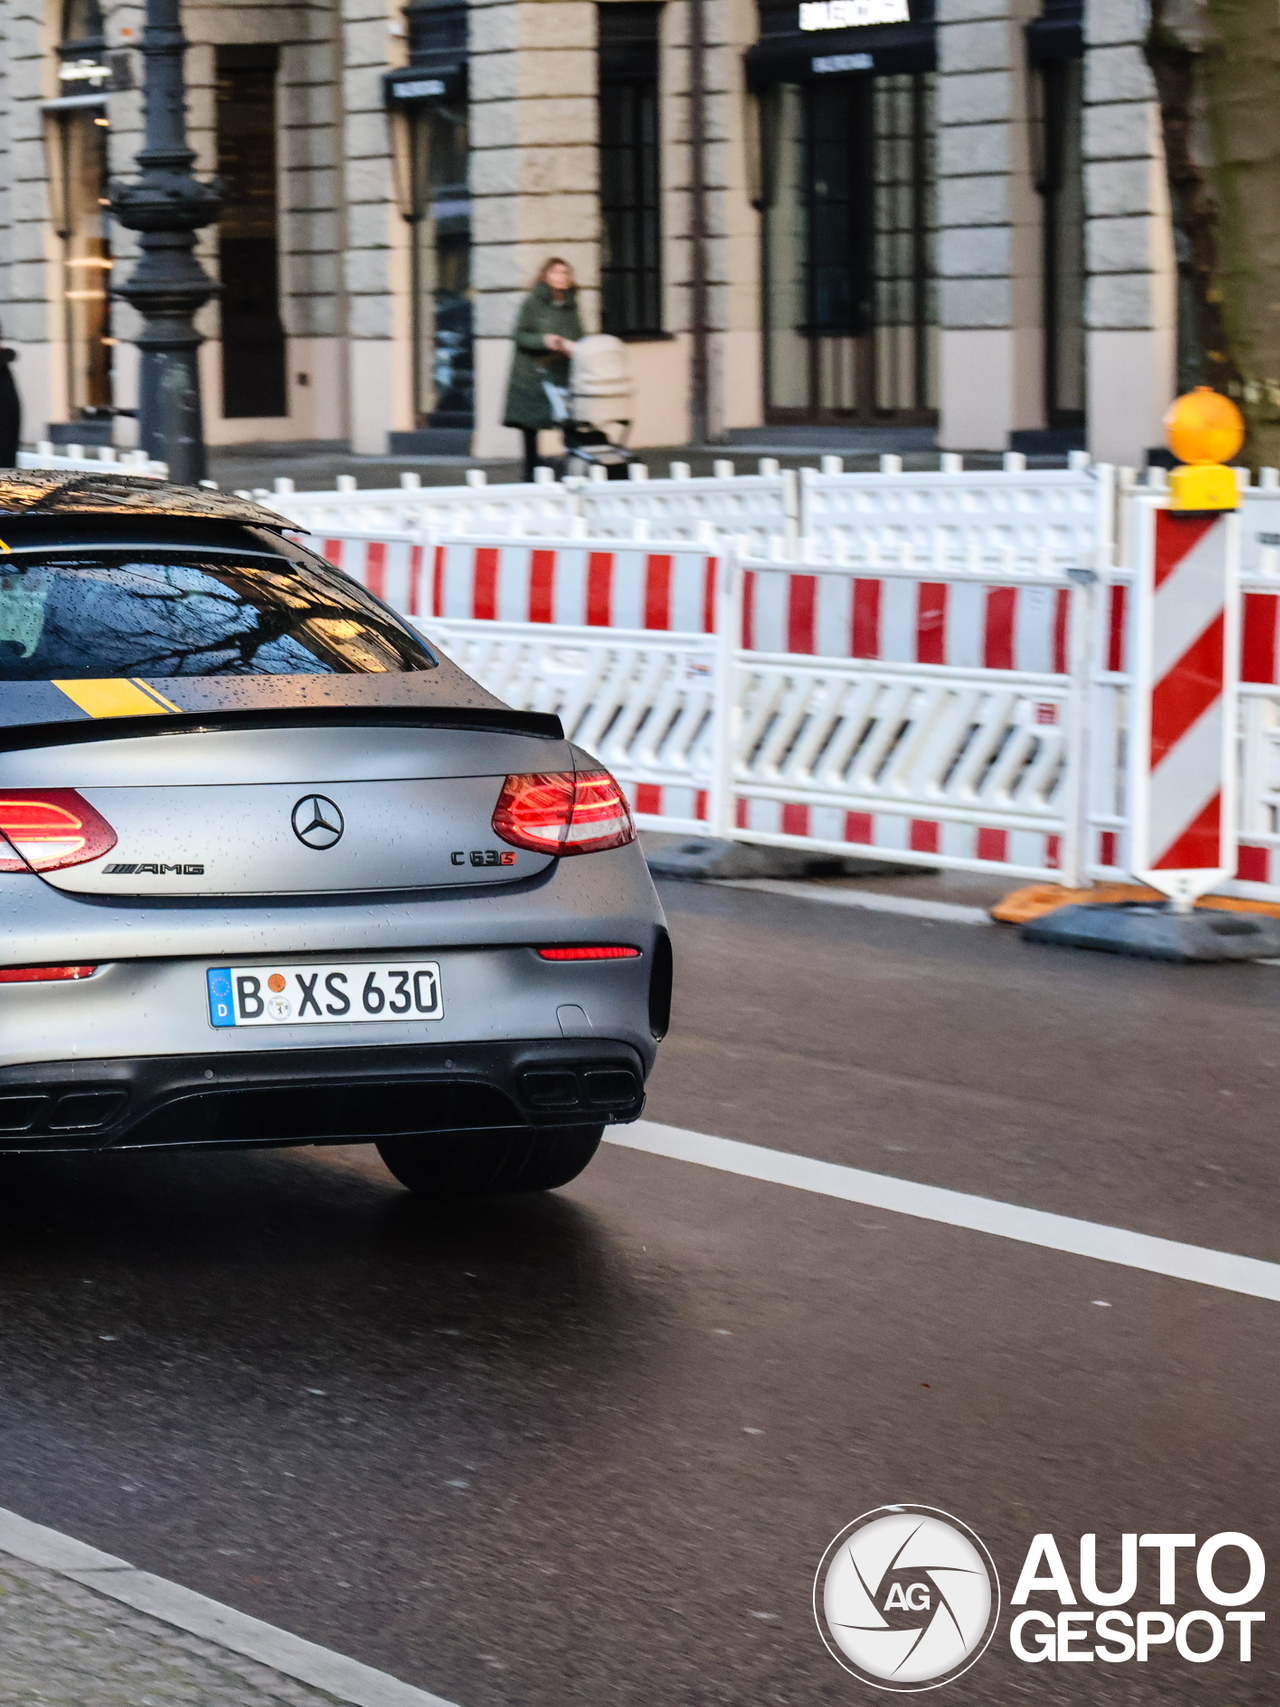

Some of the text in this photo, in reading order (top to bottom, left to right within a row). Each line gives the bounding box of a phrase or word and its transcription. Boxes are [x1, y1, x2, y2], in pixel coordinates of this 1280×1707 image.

[134, 864, 205, 875] AMG
[236, 970, 438, 1019] B XS 630
[217, 1004, 228, 1017] D
